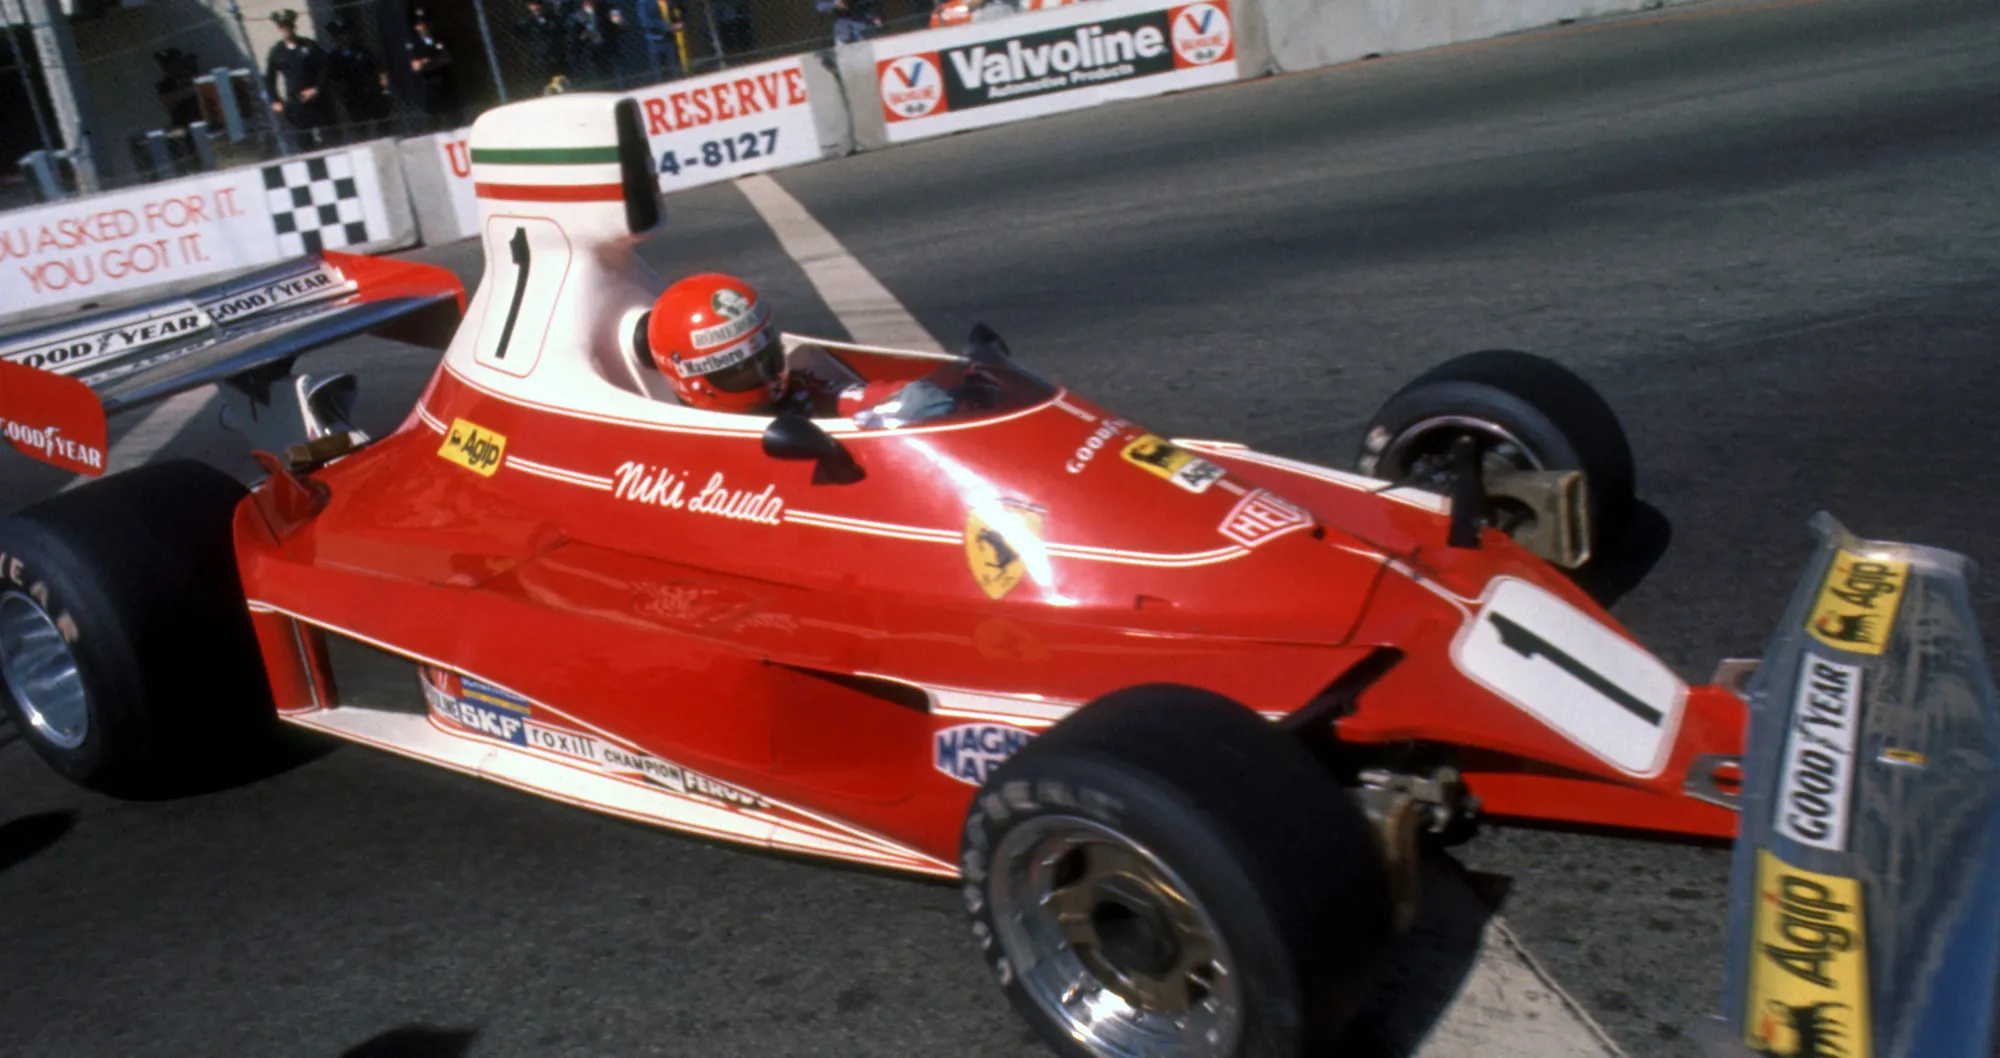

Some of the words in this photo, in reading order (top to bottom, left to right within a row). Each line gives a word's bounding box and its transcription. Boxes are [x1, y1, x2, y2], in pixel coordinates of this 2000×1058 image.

[949, 25, 1166, 90] Valvoline
[988, 75, 1067, 98] Automotive
[1070, 63, 1136, 83] Products
[643, 67, 807, 136] RESERVE
[657, 127, 780, 177] 4-8127
[37, 208, 139, 254] ASKED
[144, 195, 211, 233] FOR
[213, 187, 246, 218] IT.
[20, 255, 95, 293] YOU
[101, 239, 169, 279] GOT
[178, 233, 211, 264] IT.
[495, 227, 531, 360] 1
[460, 429, 500, 469] Agip
[614, 461, 685, 509] Niki
[688, 472, 784, 525] Lauda
[1831, 561, 1896, 609] Agip
[1486, 611, 1665, 728] 1
[460, 702, 522, 740] SKF
[533, 728, 596, 760] roxill
[602, 748, 680, 779] CHAMPION
[1762, 873, 1863, 989] Agip
